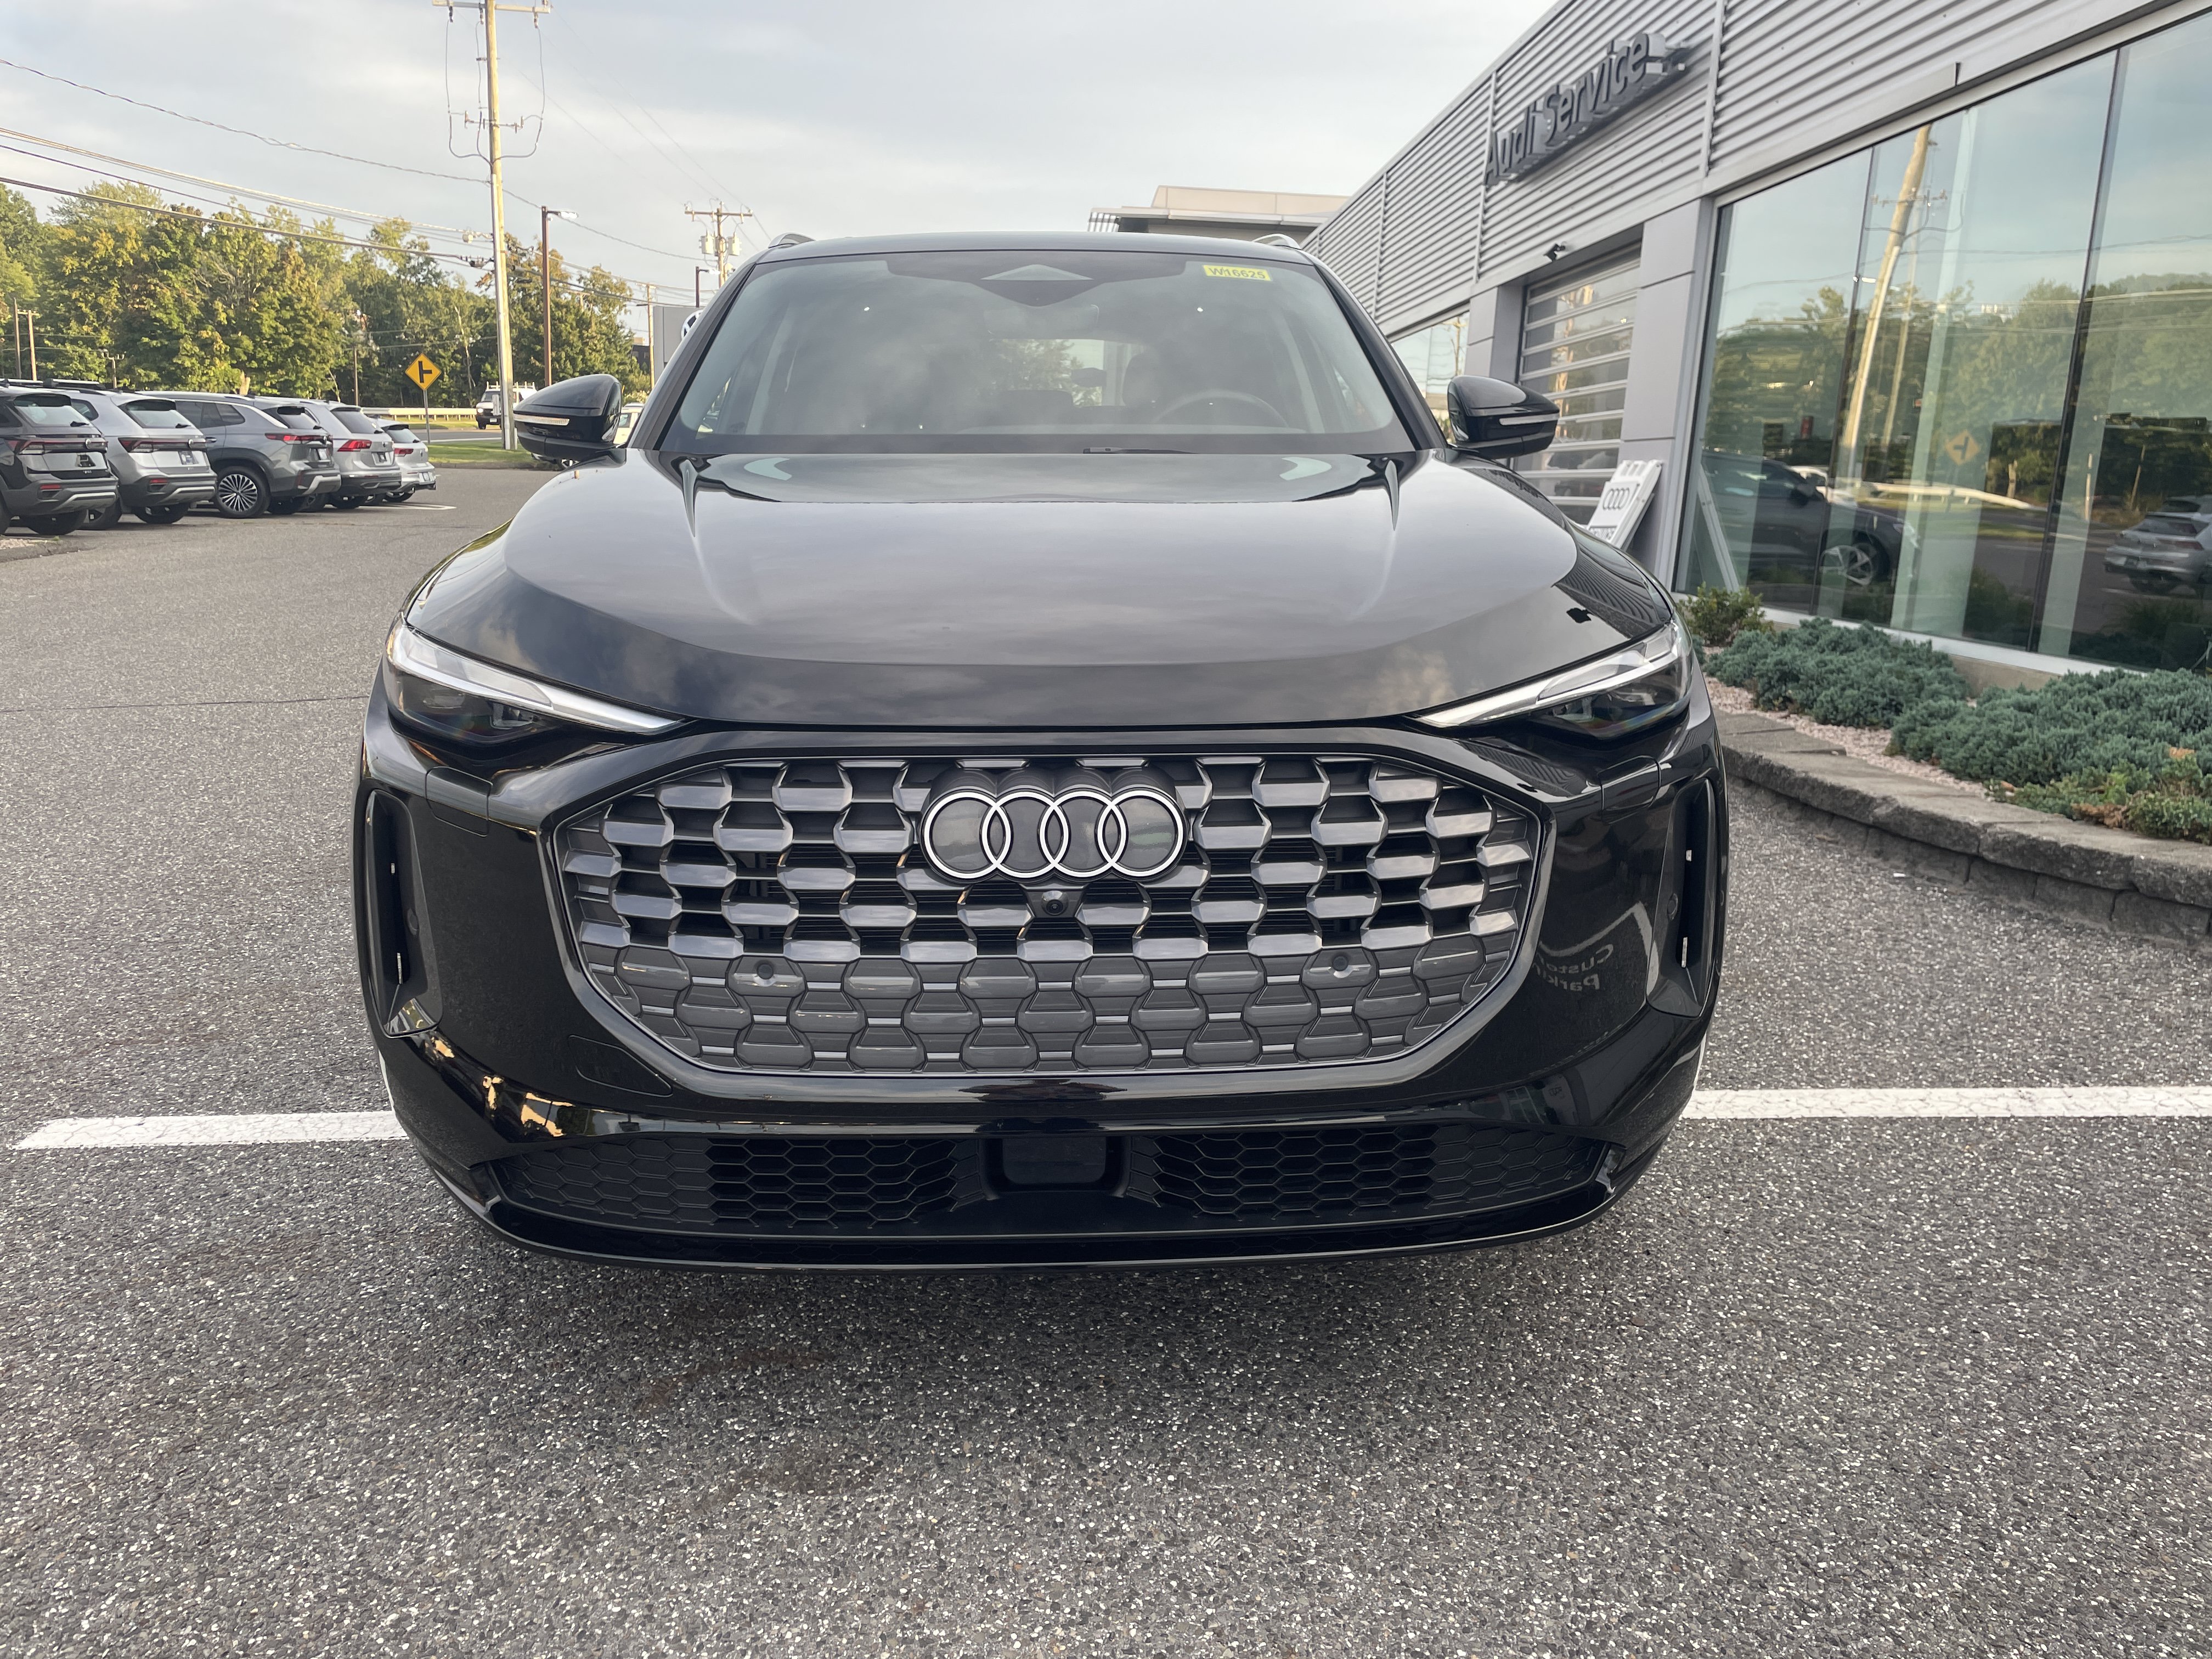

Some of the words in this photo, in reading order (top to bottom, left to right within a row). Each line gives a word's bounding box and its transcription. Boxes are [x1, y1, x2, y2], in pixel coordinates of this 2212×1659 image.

[1485, 102, 1537, 185] Audi
[1543, 32, 1651, 148] Service
[1209, 267, 1266, 280] W16625
